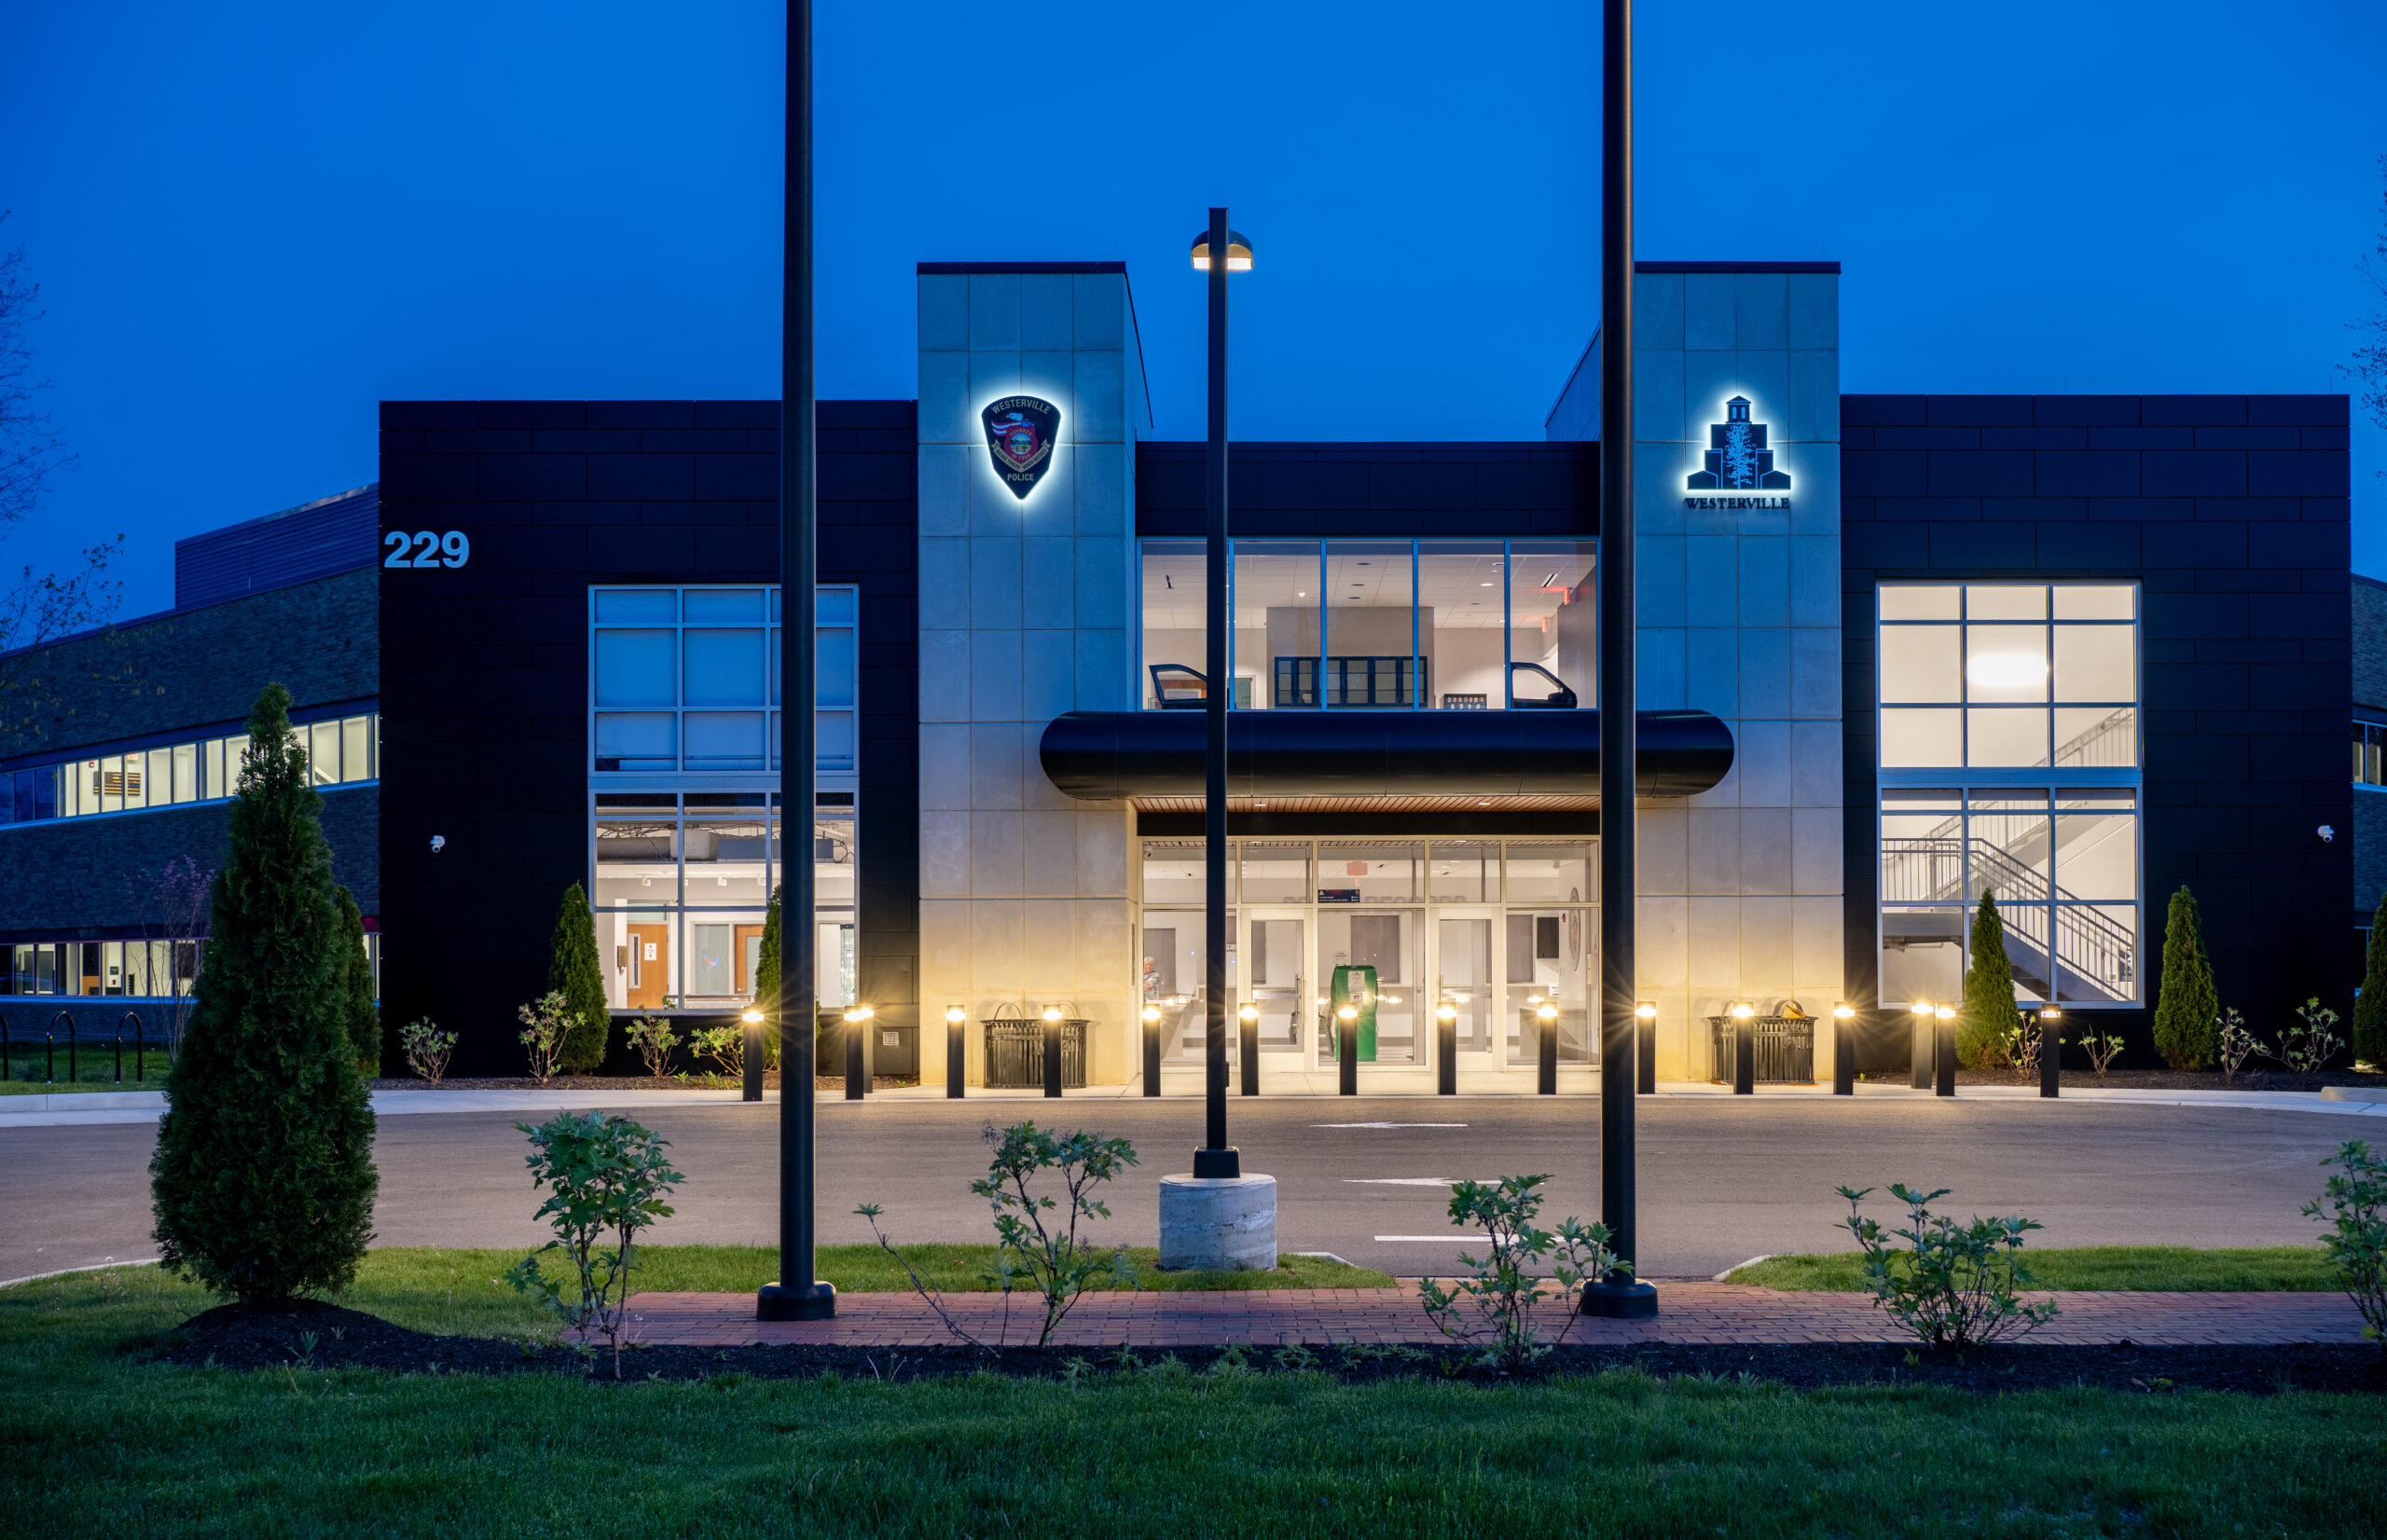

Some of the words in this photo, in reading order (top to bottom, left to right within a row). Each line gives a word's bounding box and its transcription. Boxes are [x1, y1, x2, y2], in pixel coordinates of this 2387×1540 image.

[991, 398, 1052, 415] WESTERVILLE
[1685, 497, 1790, 509] WESTERVILLE
[383, 530, 470, 569] 229
